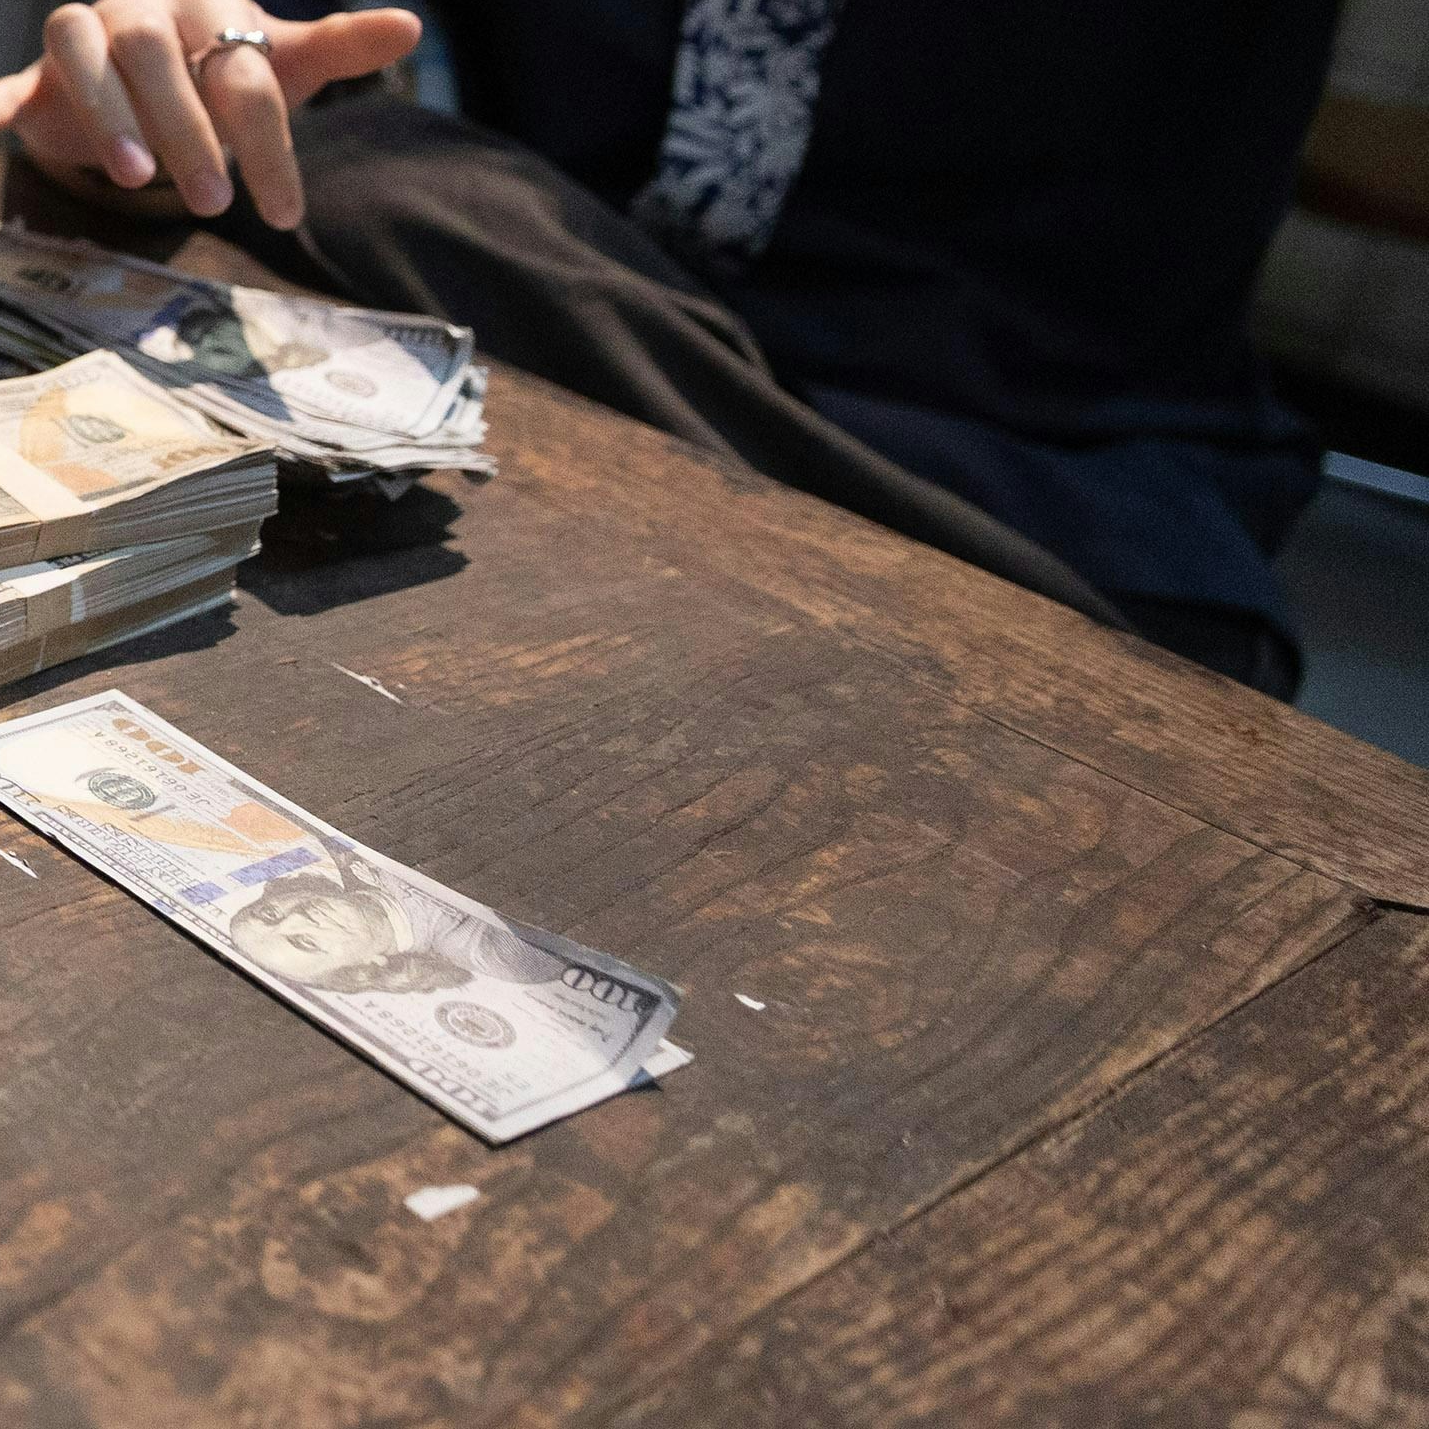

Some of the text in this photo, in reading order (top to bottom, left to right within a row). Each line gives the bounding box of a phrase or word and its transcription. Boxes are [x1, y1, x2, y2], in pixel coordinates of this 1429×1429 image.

[102, 738, 188, 792] 06161268
[111, 717, 205, 774] 100
[560, 963, 640, 1012] 100
[375, 1008, 483, 1080] 06161268
[409, 1058, 496, 1119] 100
